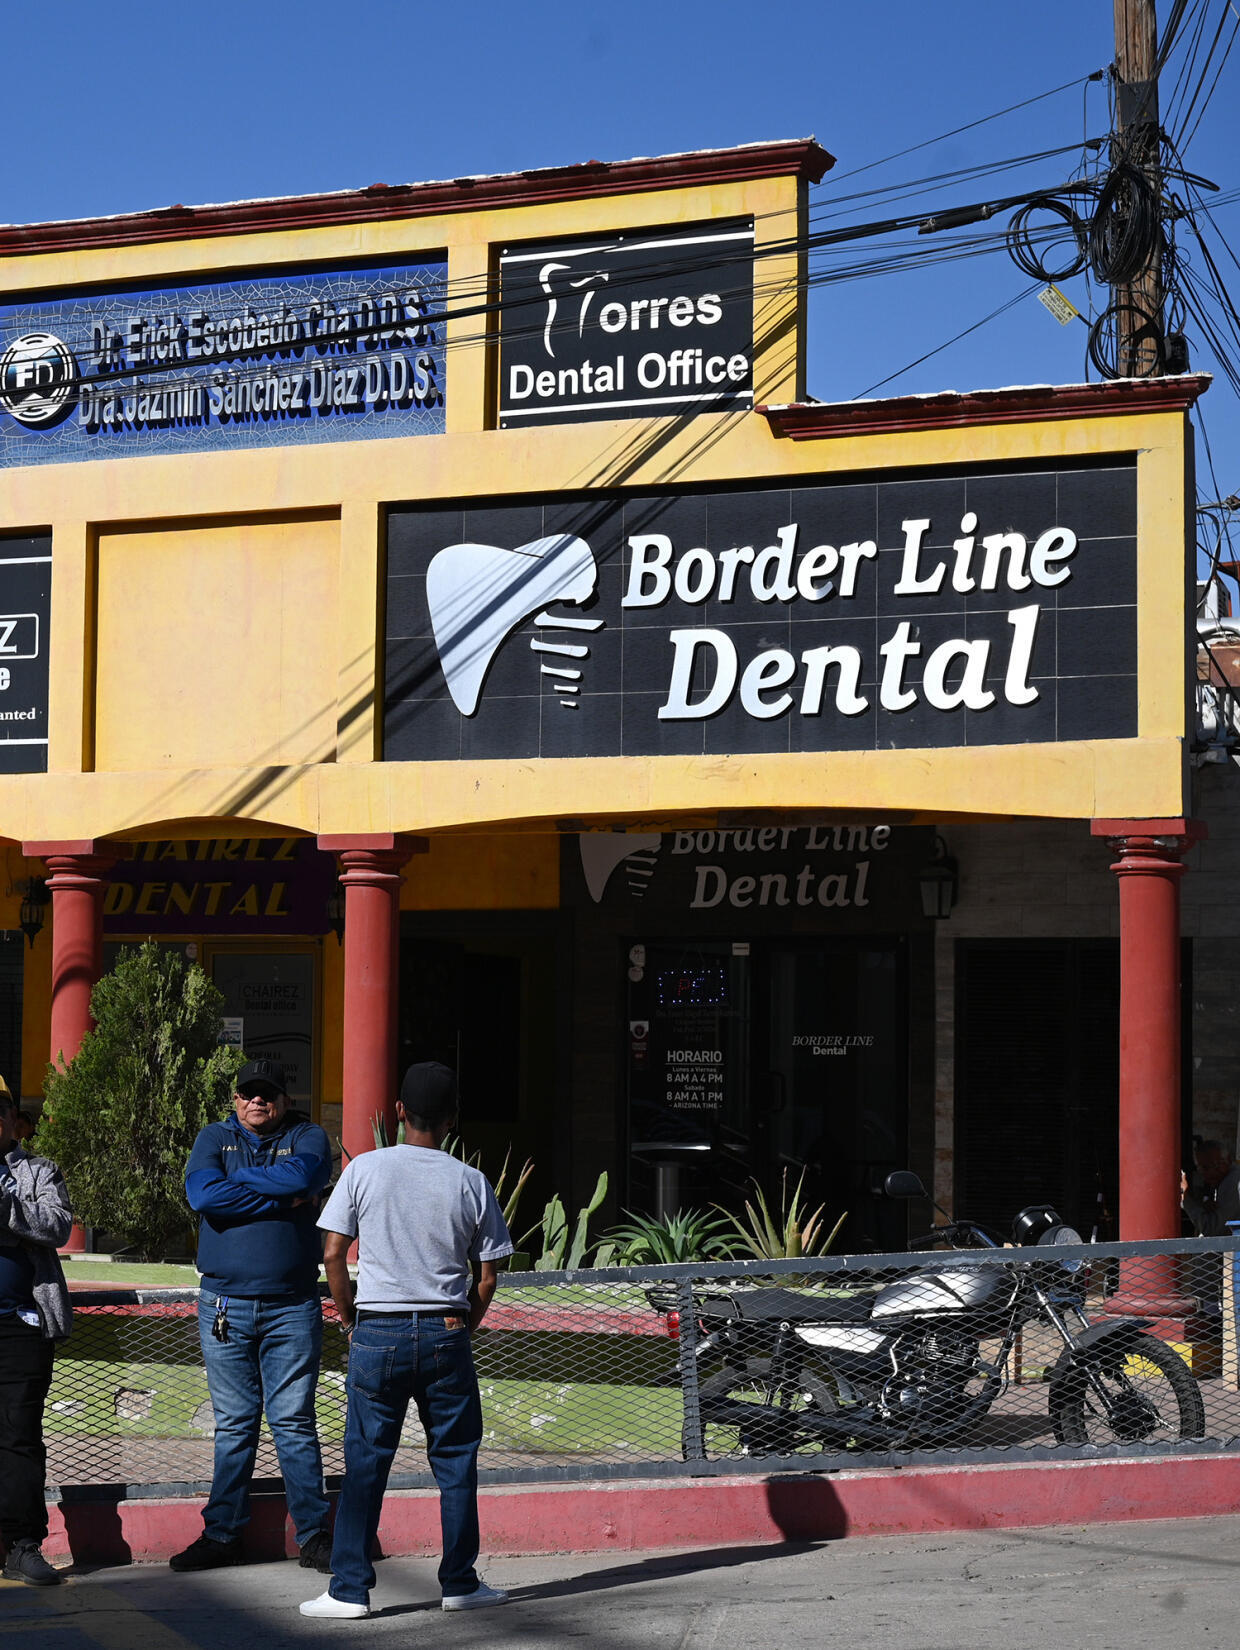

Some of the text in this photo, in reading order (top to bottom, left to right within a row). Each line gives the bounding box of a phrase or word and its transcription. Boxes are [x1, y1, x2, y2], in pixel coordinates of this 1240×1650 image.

[90, 320, 121, 366] Dr.
[126, 312, 182, 362] Erick
[187, 302, 298, 357] Escobedo
[305, 299, 350, 344] Cha
[16, 361, 53, 388] FD
[365, 351, 437, 404] D.D.S.
[510, 349, 749, 400] Dental Office
[622, 511, 1078, 607] Border Line
[657, 604, 1041, 721] Dental
[671, 824, 891, 855] Border Line
[103, 881, 290, 917] DENTAL
[689, 861, 871, 909] Dental
[243, 985, 300, 999] CHAIREZ
[791, 1035, 875, 1046] BORDER LINE
[812, 1045, 847, 1056] Dental
[666, 1050, 723, 1063] HORARIO
[666, 1073, 723, 1083] 8 AM A 4 PM
[666, 1091, 673, 1101] 8
[674, 1091, 690, 1101] AM
[691, 1091, 699, 1101] A
[708, 1091, 723, 1101] PM
[673, 1102, 718, 1110] ARIZONA TIME
